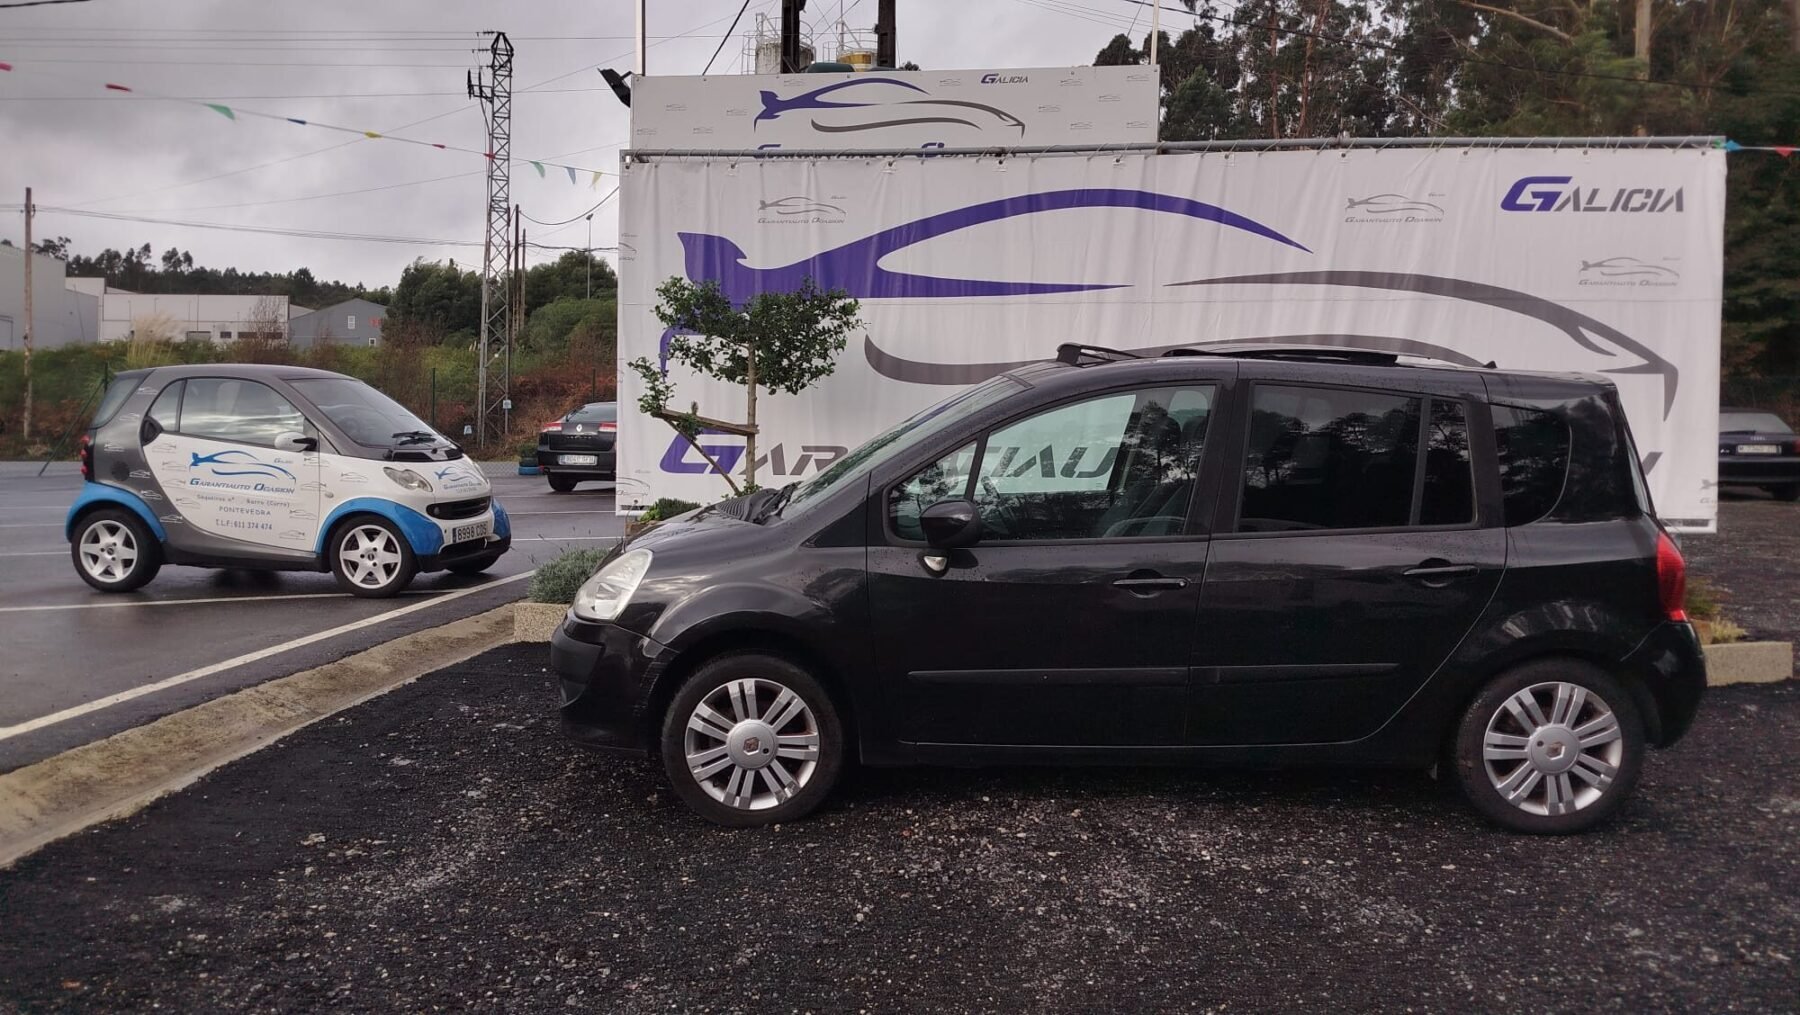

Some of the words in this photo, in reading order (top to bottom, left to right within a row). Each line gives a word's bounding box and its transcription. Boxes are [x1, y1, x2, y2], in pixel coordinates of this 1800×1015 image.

[980, 73, 1029, 84] GALICIA
[1500, 176, 1684, 213] GALICIA
[218, 505, 272, 516] PONTEVEDRA
